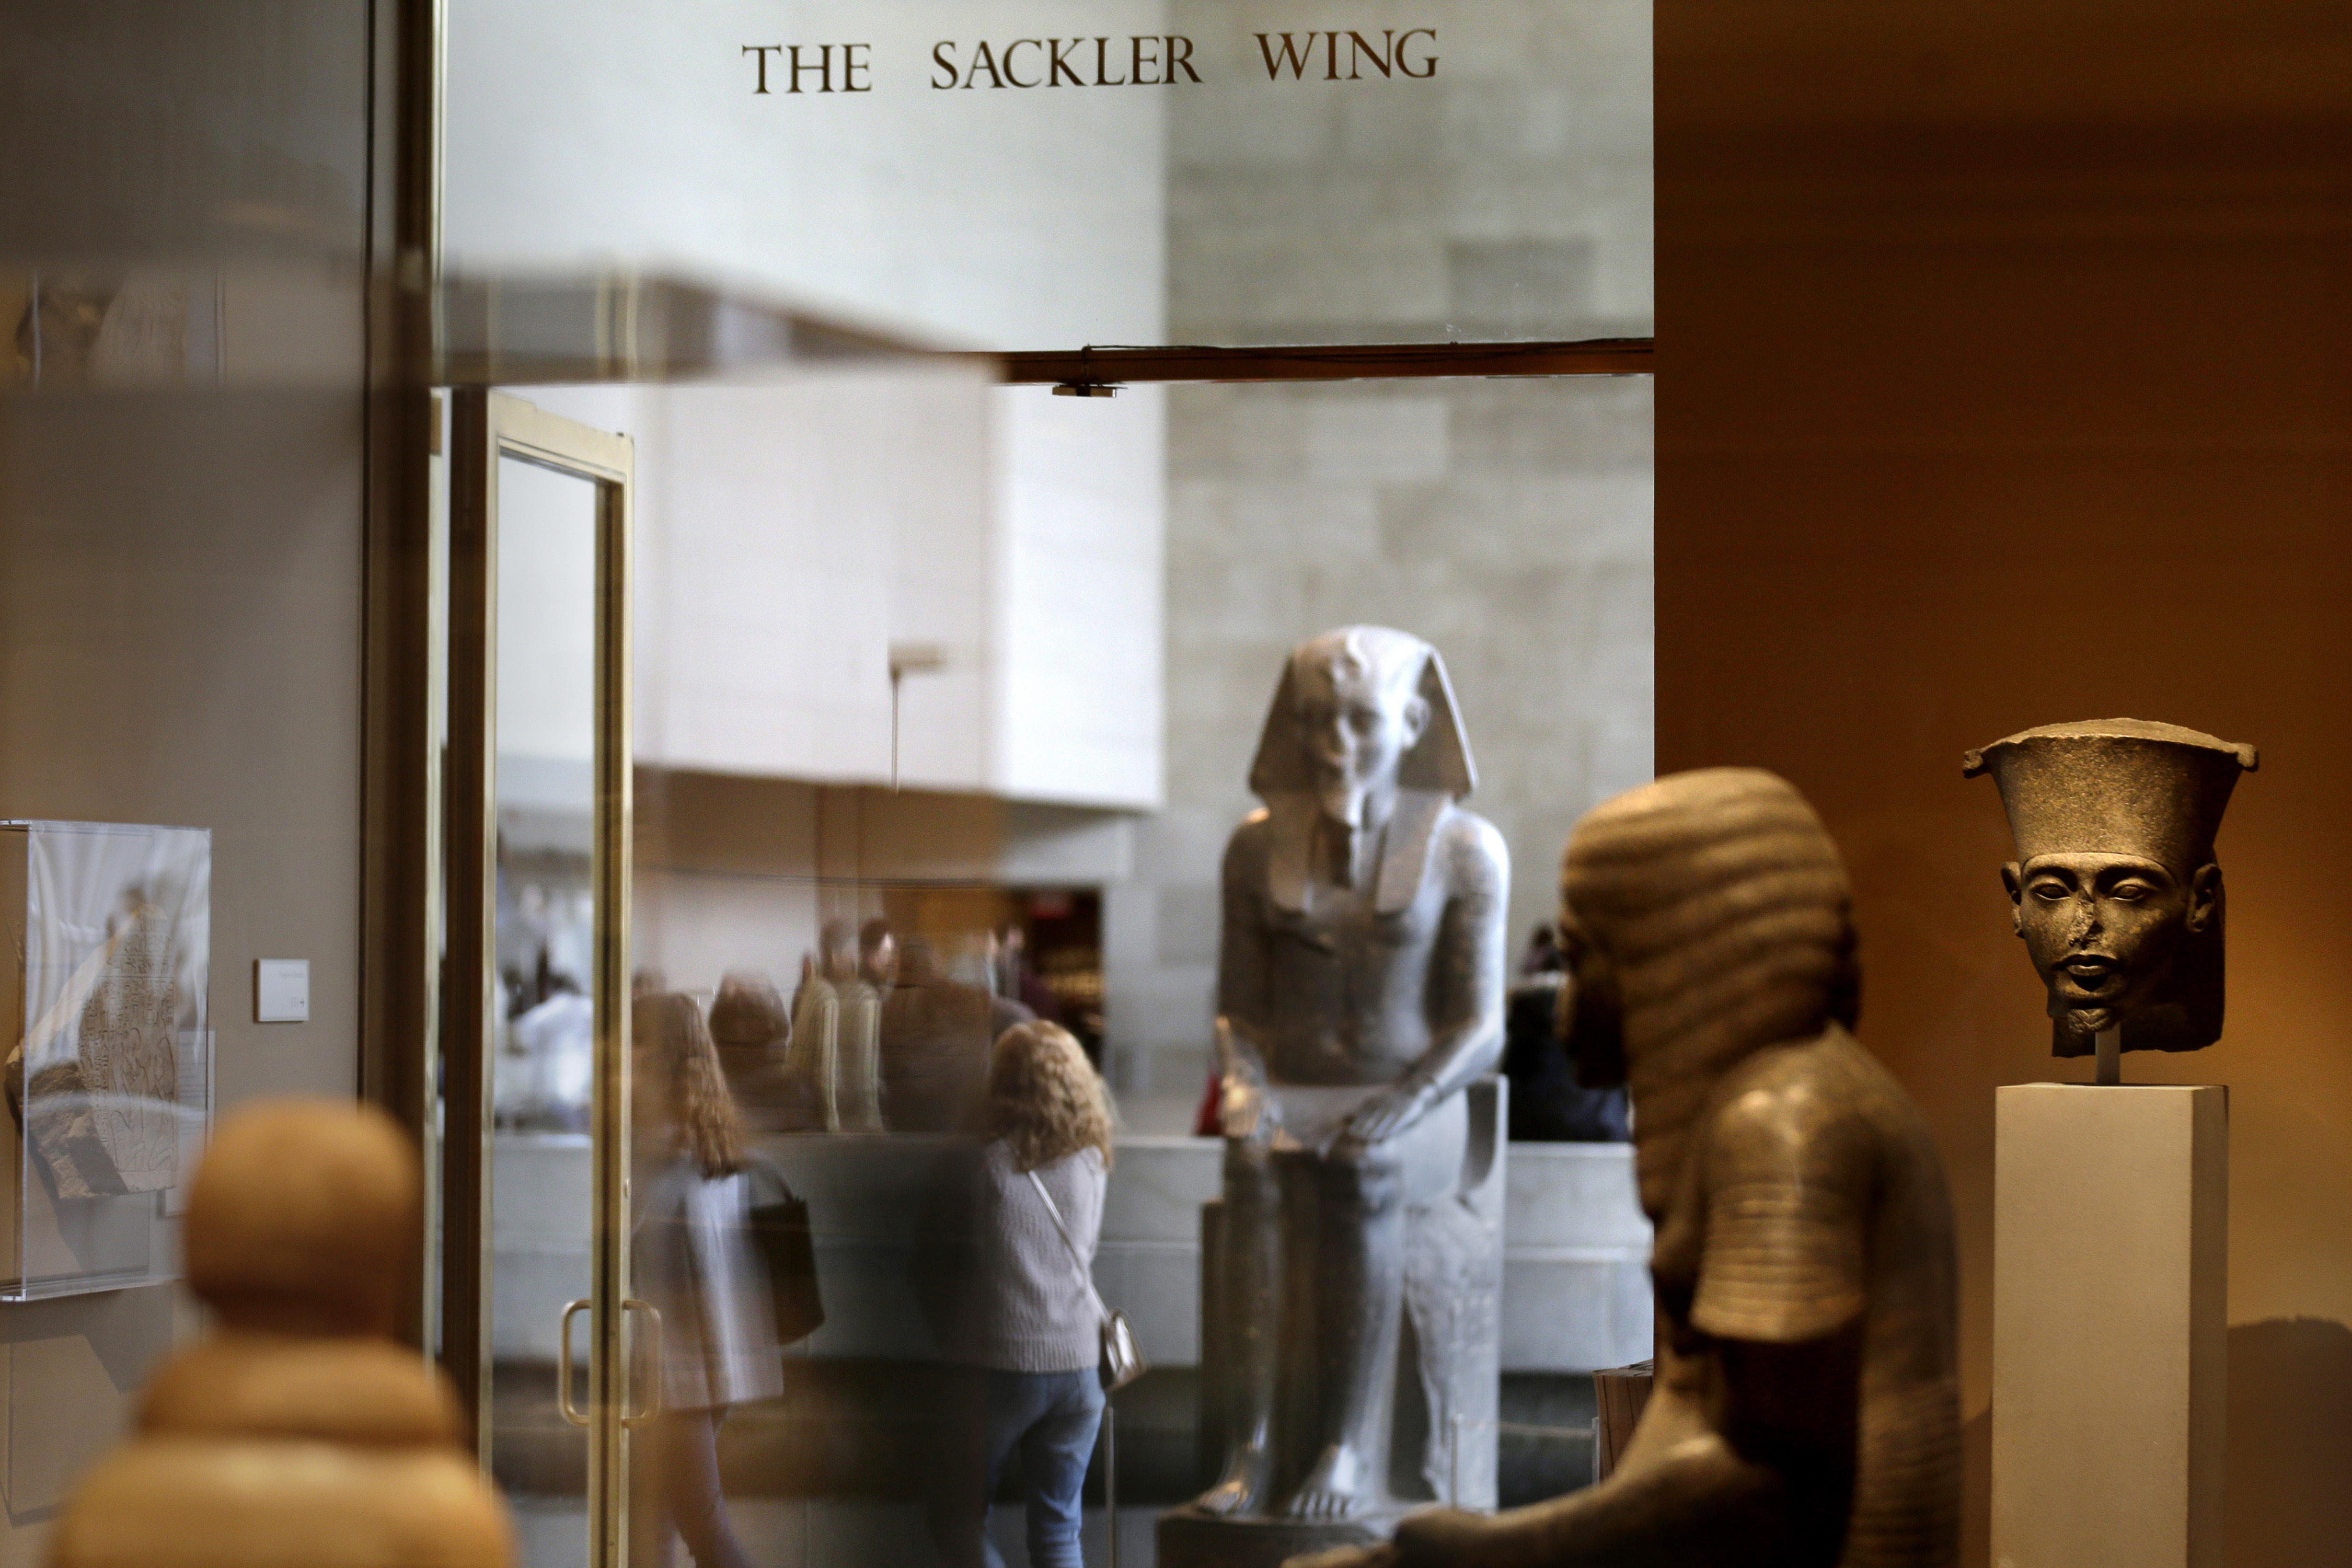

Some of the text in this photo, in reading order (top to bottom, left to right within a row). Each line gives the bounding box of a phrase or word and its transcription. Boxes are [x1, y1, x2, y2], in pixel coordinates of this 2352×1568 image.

[742, 28, 1439, 94] THE SACKLER WING
